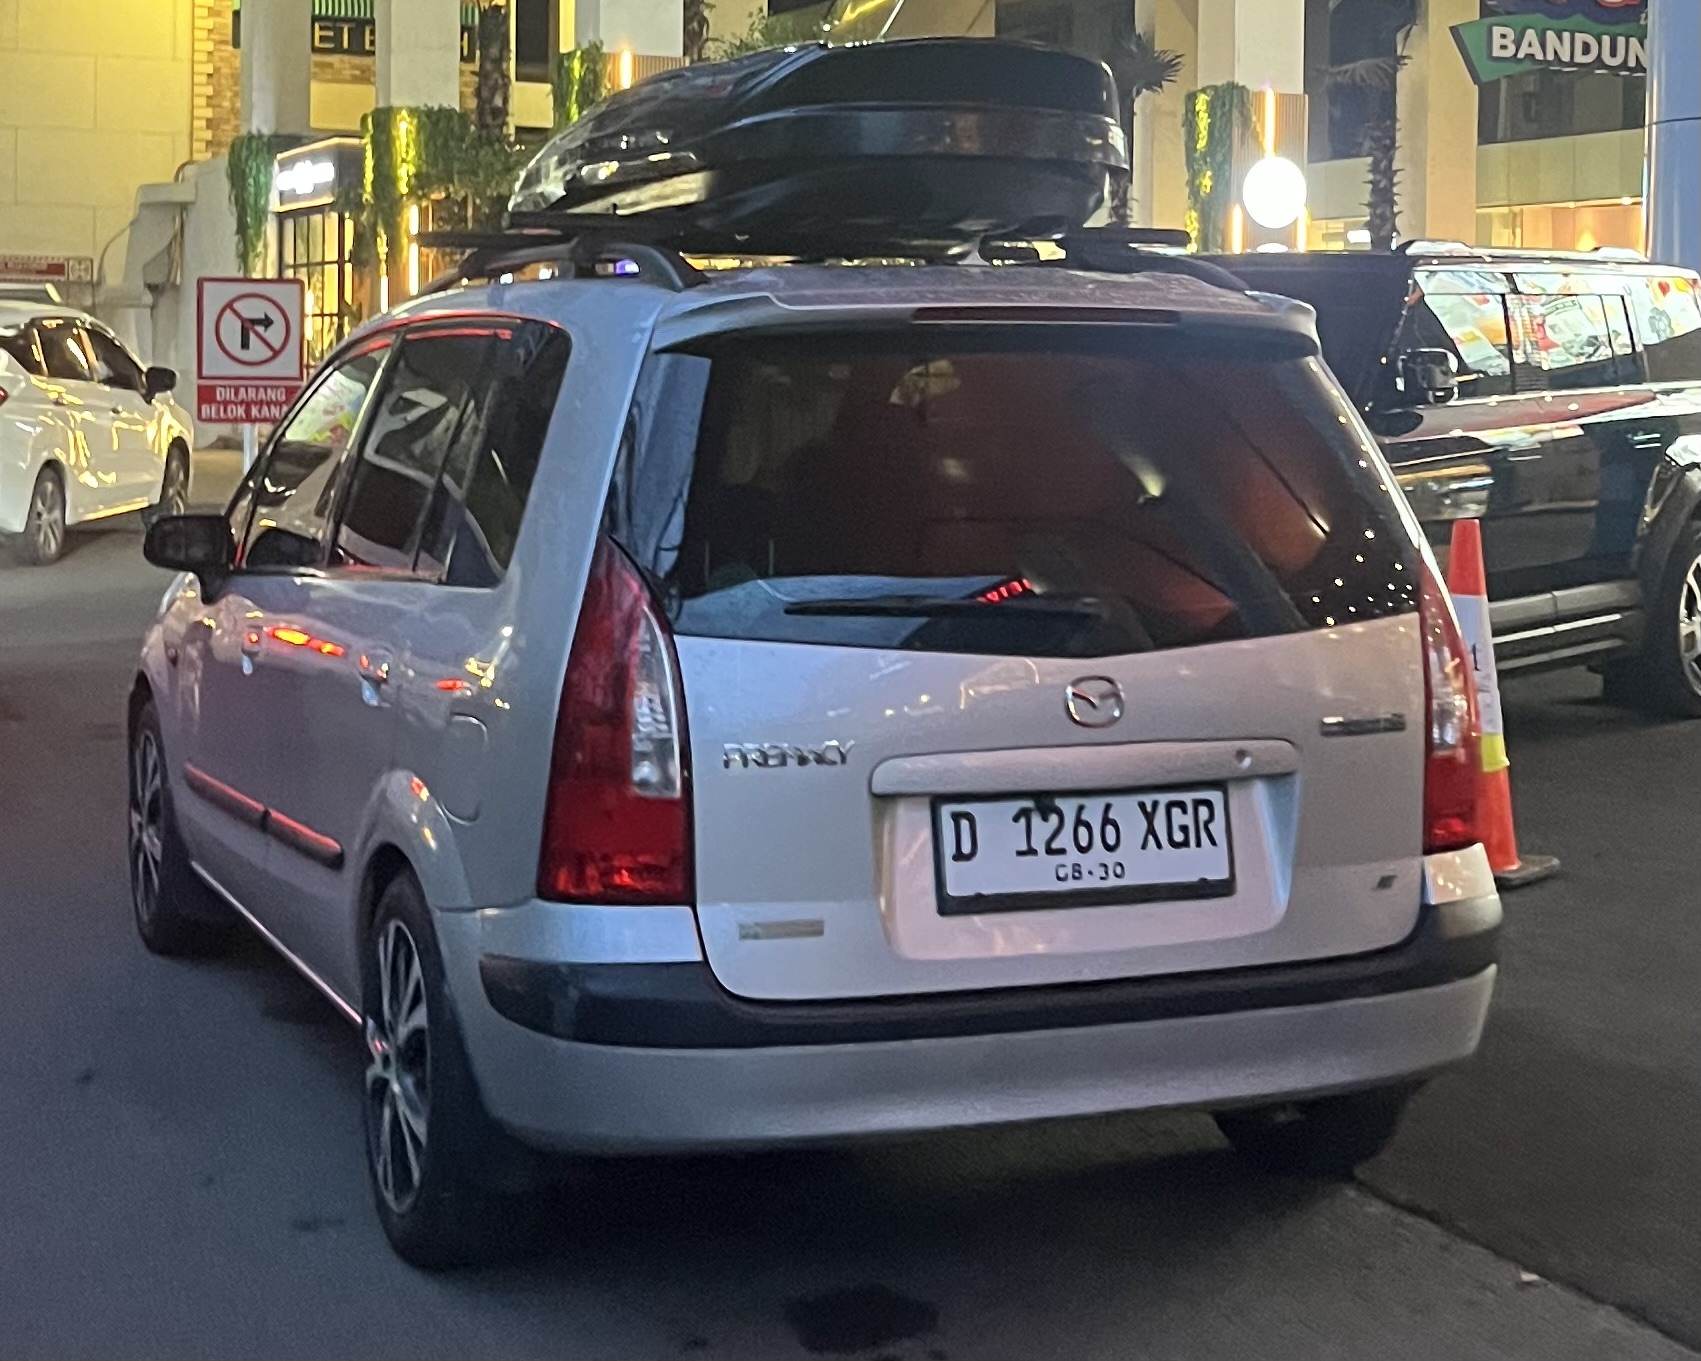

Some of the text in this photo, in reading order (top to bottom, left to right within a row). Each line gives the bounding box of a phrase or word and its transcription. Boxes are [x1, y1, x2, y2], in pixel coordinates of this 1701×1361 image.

[1492, 26, 1648, 68] BANDUN
[215, 386, 287, 401] DILARANG
[201, 403, 247, 419] BELOK
[951, 798, 1218, 862] D 1266 XGR
